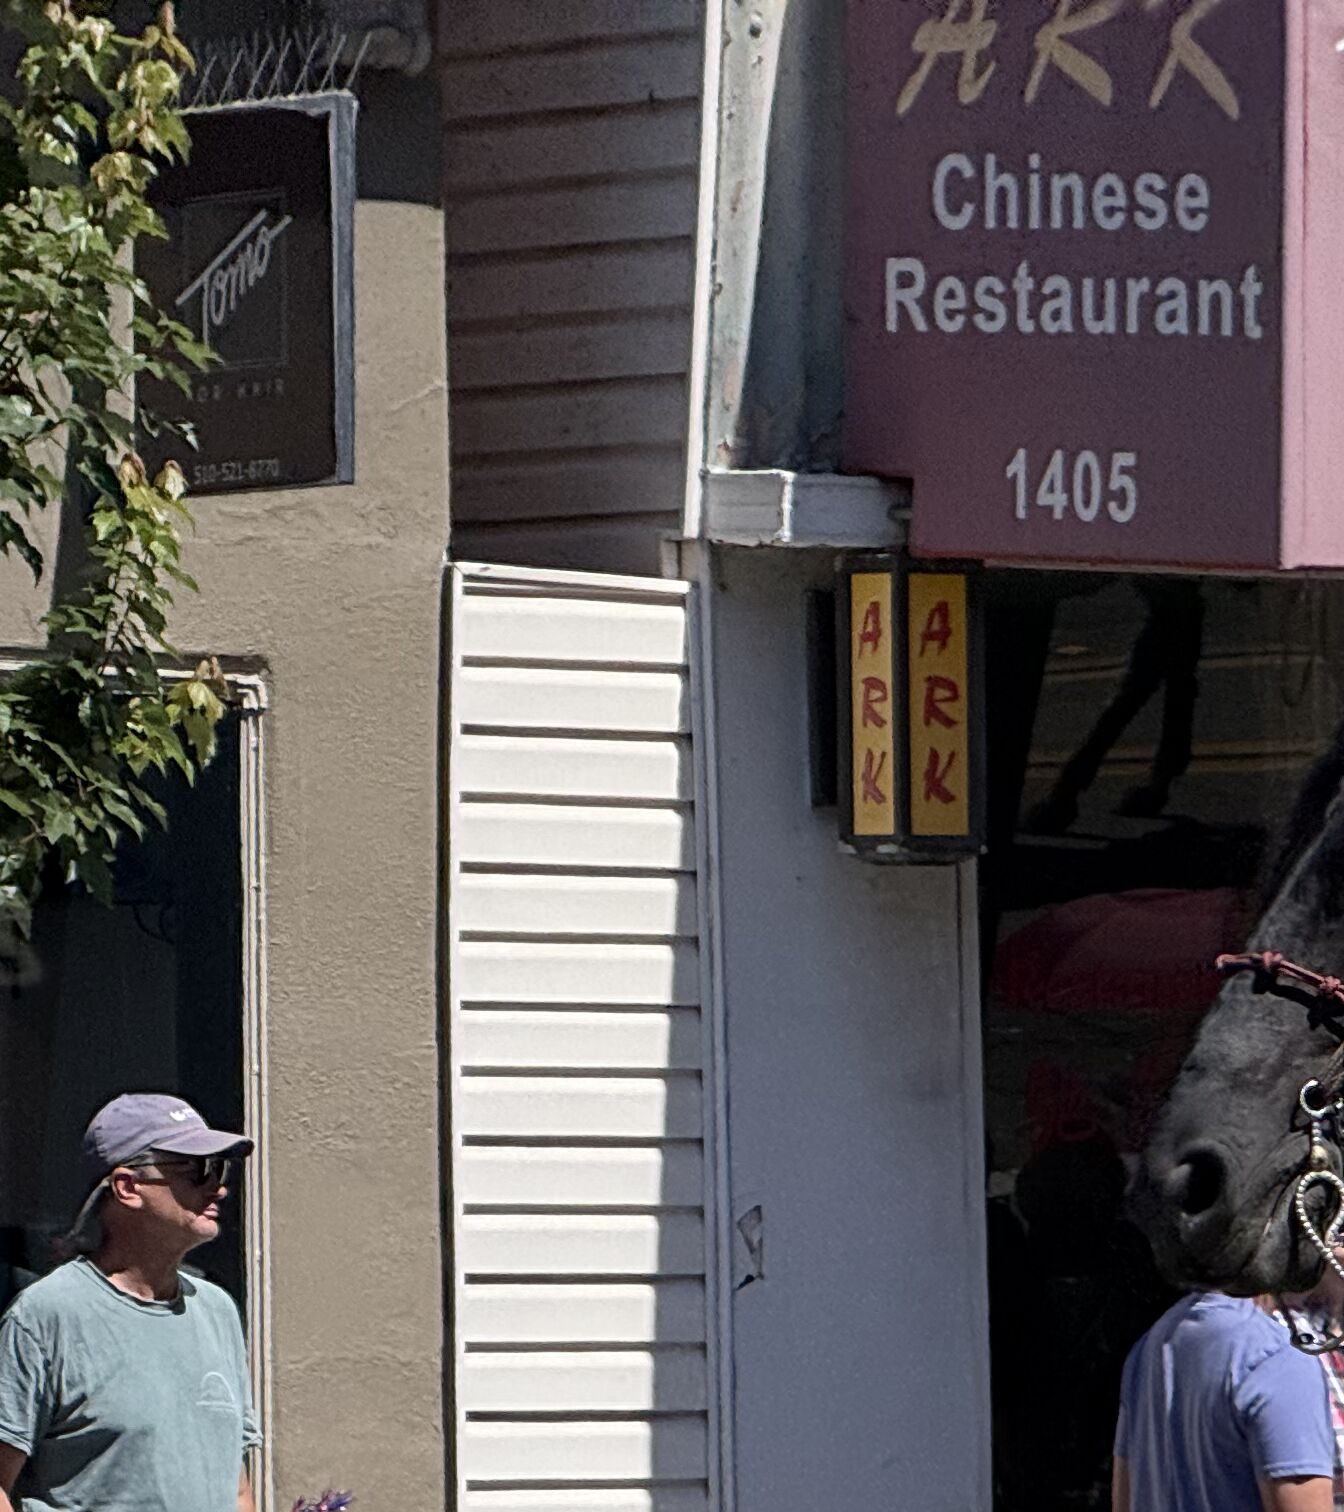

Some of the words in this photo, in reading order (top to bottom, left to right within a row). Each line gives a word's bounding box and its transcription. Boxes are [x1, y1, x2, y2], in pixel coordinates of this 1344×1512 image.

[932, 153, 1210, 232] Chinese
[176, 208, 293, 347] Tomo
[884, 257, 1264, 340] Restaurant
[1005, 447, 1139, 524] 1405
[858, 600, 889, 806] ARK
[919, 600, 960, 806] ARK
